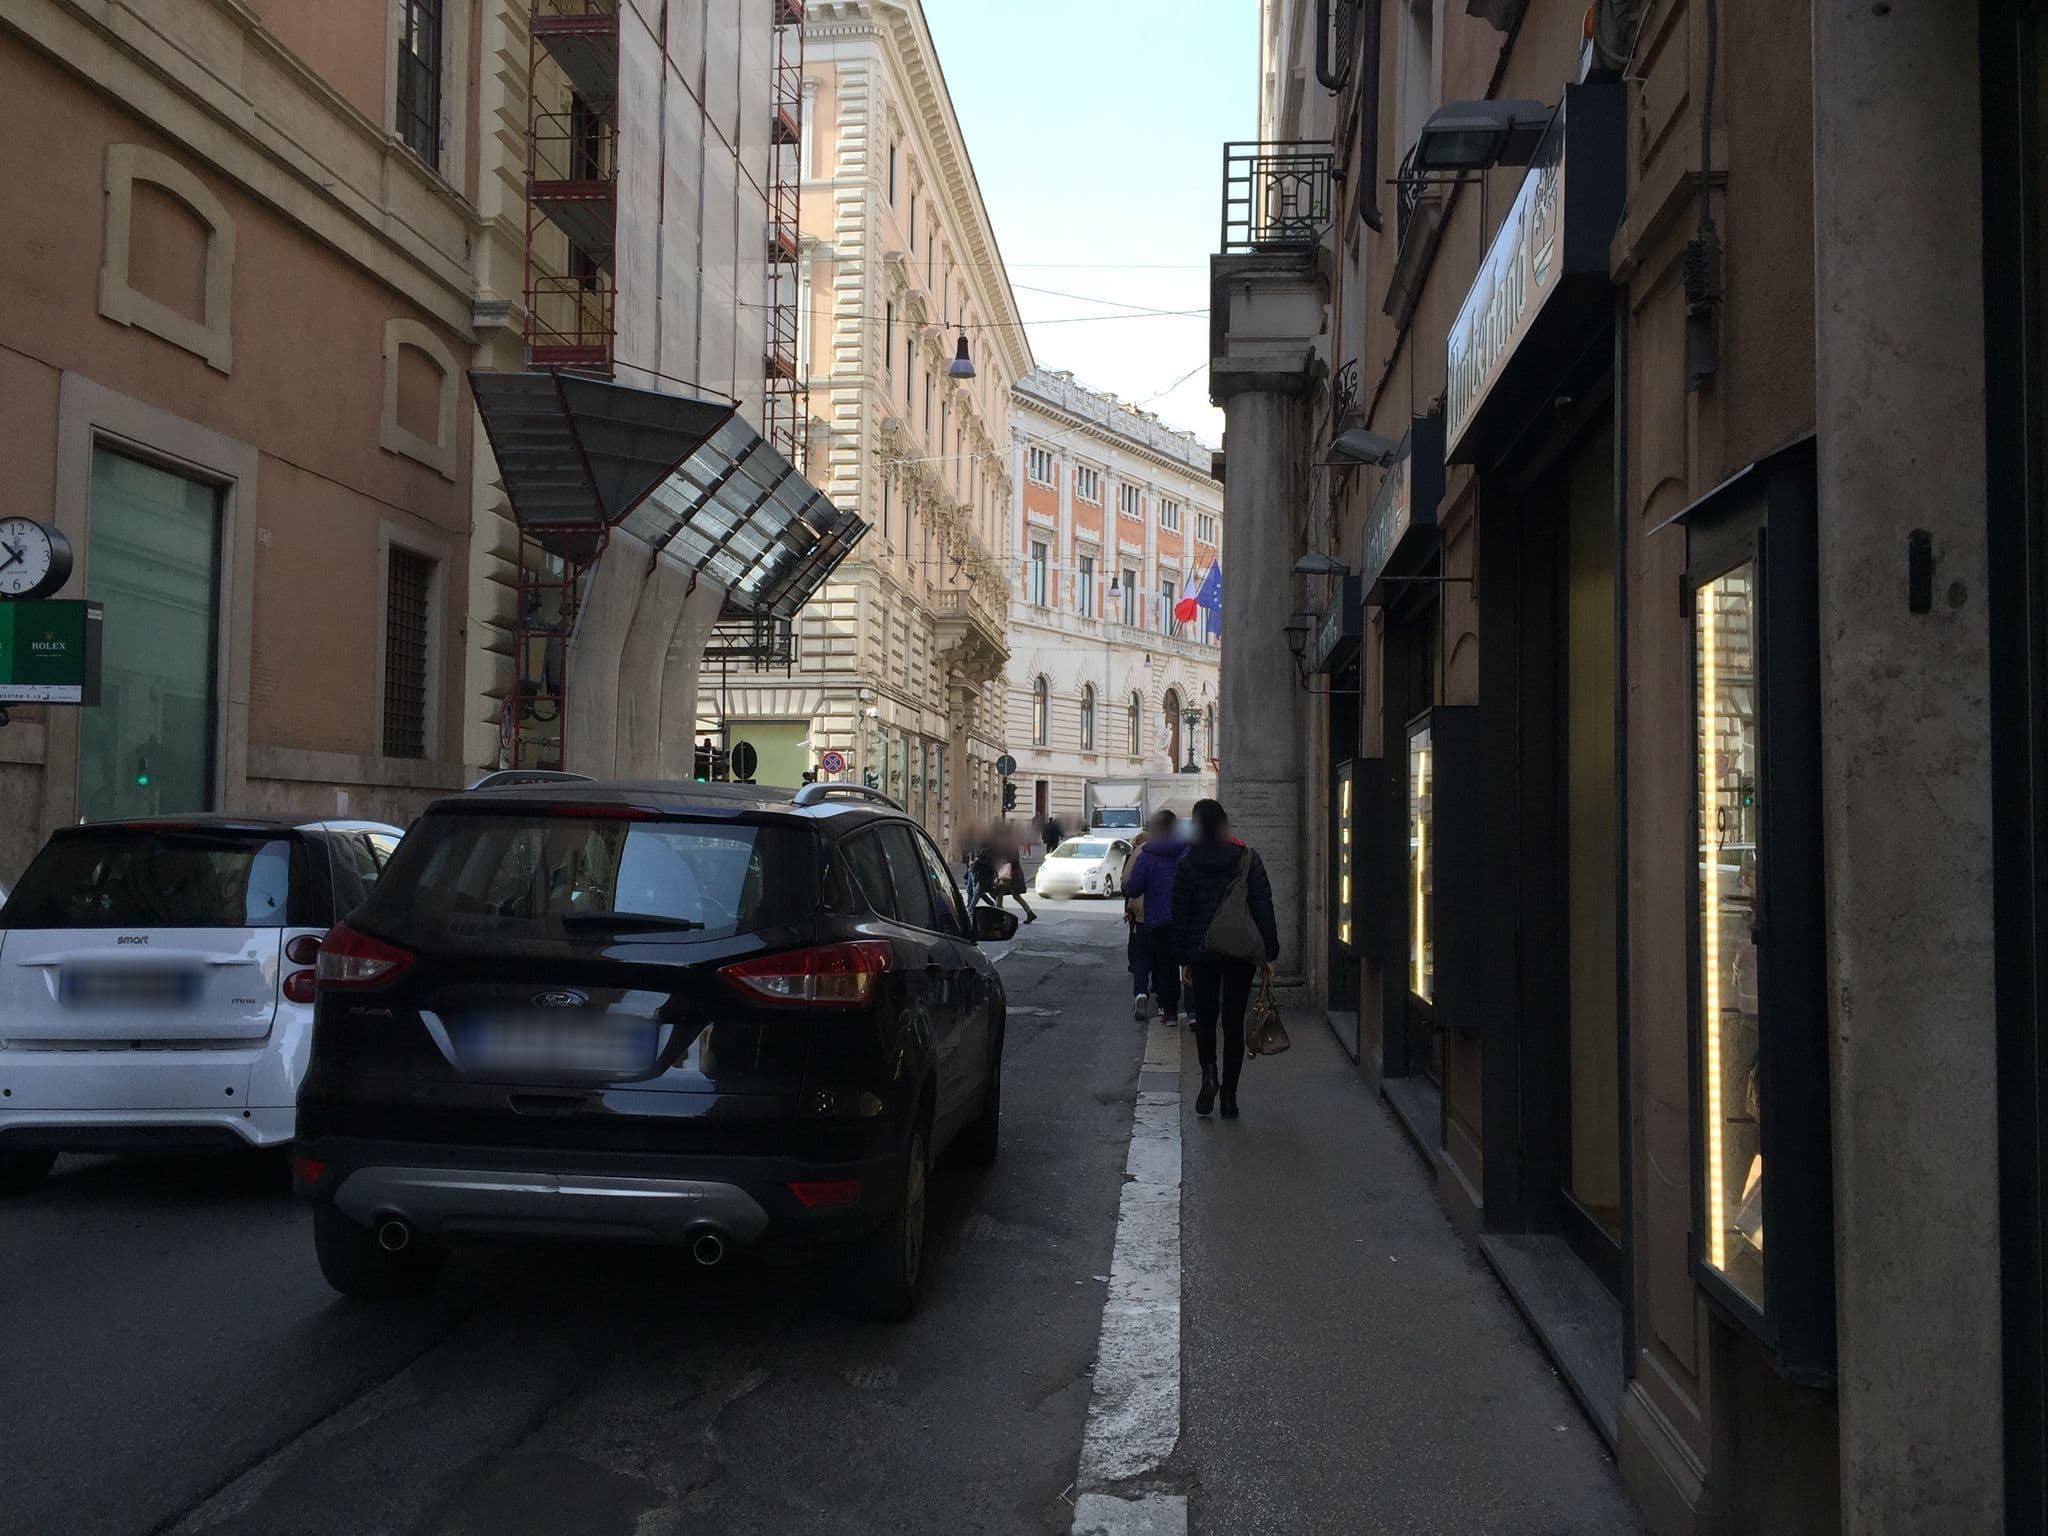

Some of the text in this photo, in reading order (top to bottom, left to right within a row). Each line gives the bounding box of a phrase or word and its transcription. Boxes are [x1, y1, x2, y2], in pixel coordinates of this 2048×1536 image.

[11, 523, 25, 536] 12
[43, 549, 50, 563] 3
[13, 578, 21, 591] 6
[32, 642, 66, 650] ROLEX
[117, 936, 149, 945] smart
[543, 994, 572, 1007] Ford
